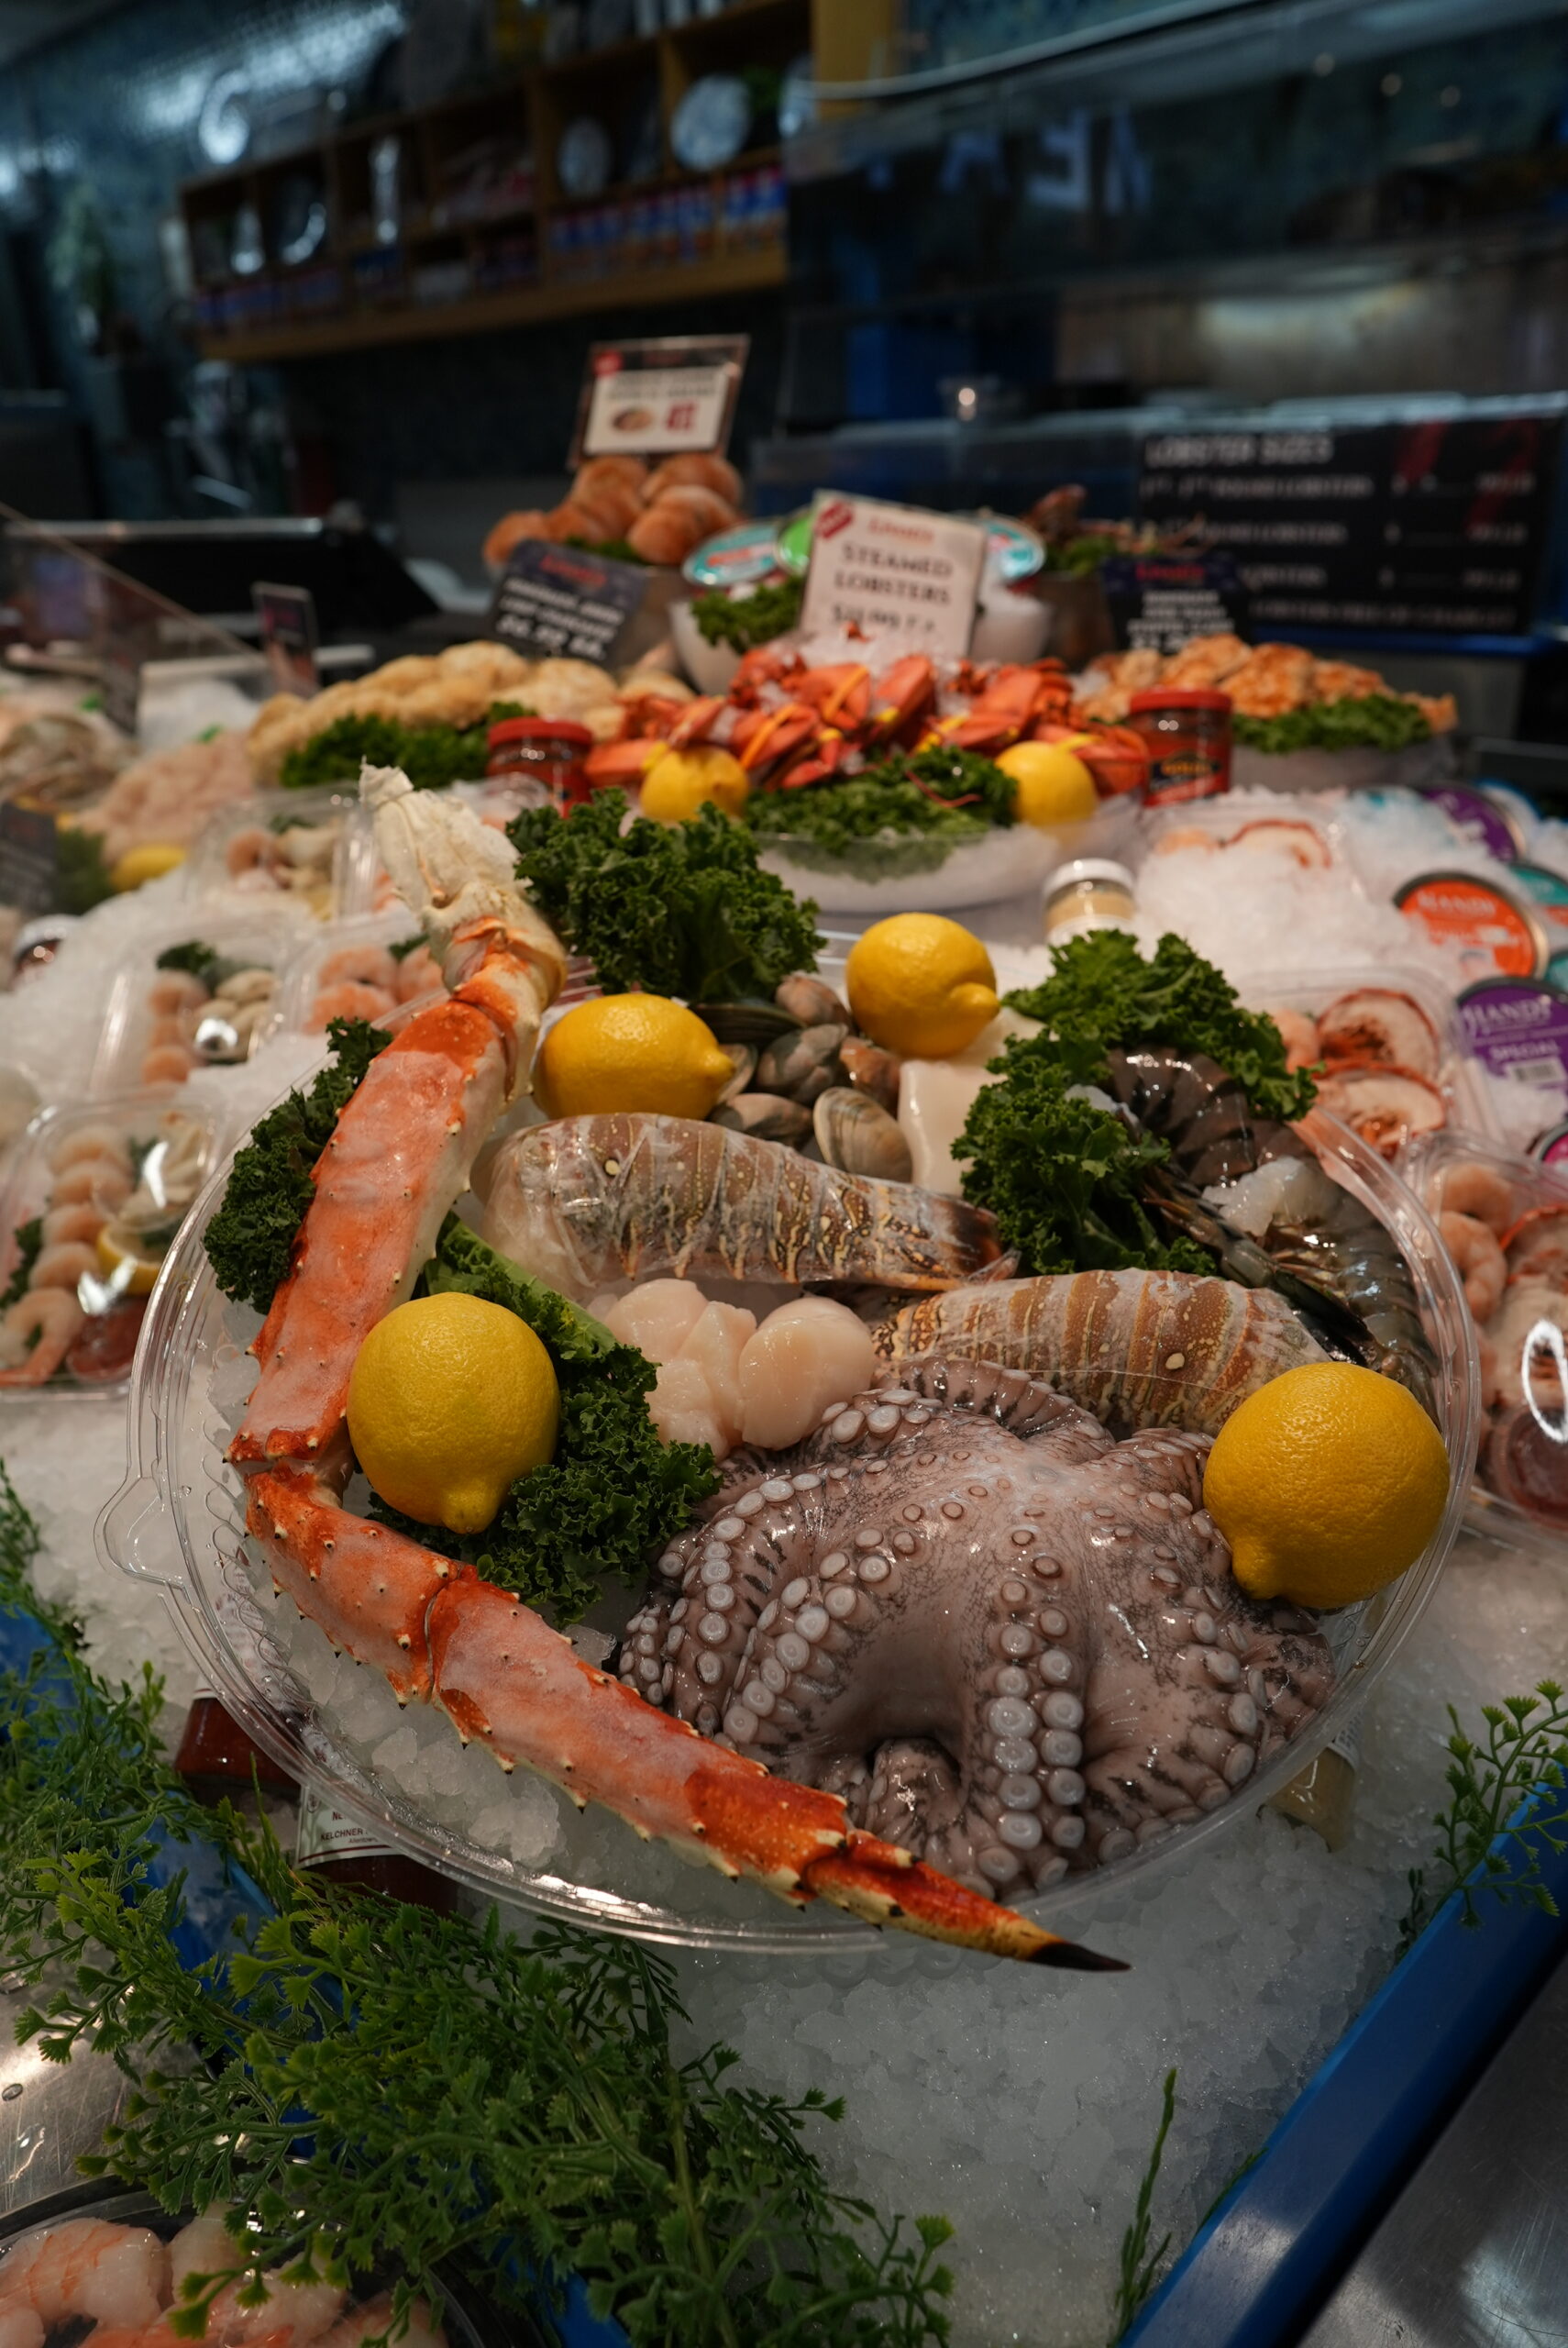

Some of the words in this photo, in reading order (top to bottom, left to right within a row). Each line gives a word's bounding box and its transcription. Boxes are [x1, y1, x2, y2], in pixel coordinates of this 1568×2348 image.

[842, 543, 954, 578] STEAMED
[834, 570, 951, 605] LOBSTERS
[321, 1827, 364, 1842] KELCHNER
